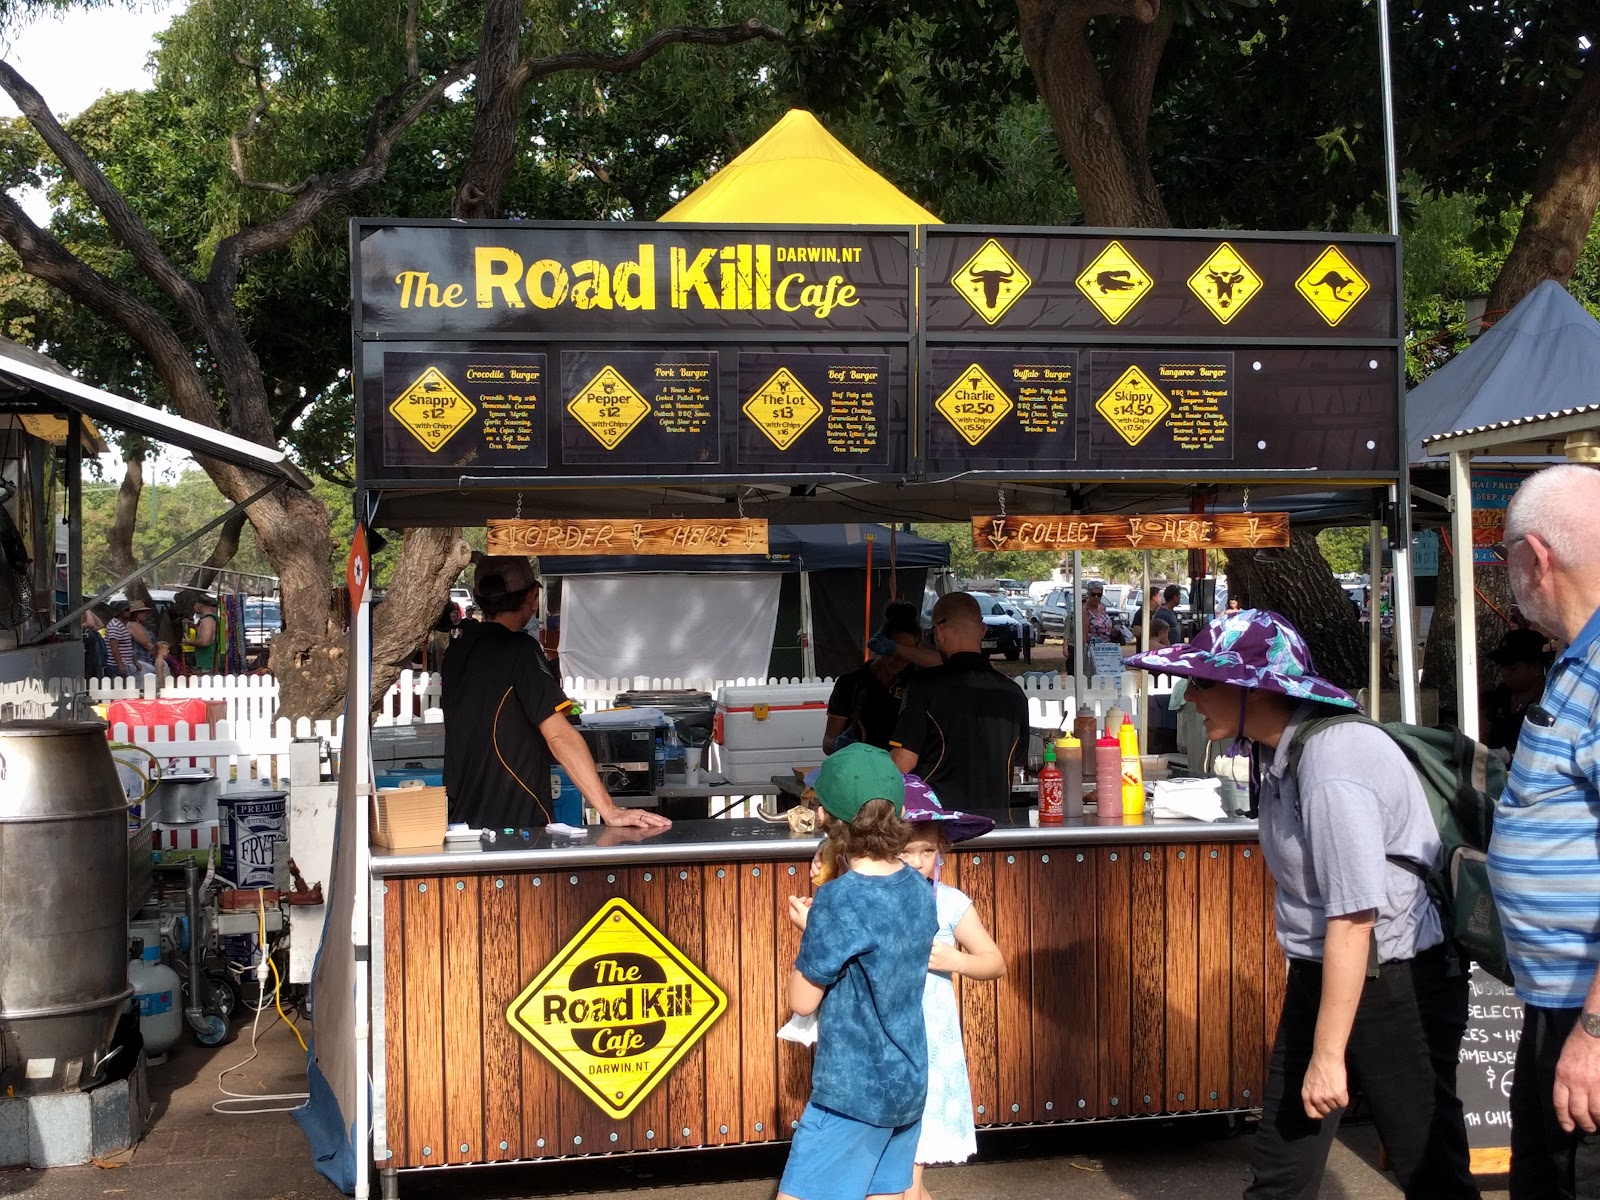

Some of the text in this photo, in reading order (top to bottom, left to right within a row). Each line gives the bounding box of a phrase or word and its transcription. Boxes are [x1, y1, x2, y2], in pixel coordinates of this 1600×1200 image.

[395, 244, 860, 319] The Road Kill Cafe
[467, 369, 540, 381] Crocodile Burger
[655, 368, 709, 379] Pork Burger
[828, 370, 878, 382] Beef Burger
[1013, 369, 1071, 380] Buffalo Burger
[1159, 367, 1226, 378] Kangaroo Burger
[409, 394, 457, 408] Snappy
[587, 393, 632, 406] Pepper
[761, 394, 806, 405] The Lot
[954, 390, 995, 400] Charlie
[1115, 391, 1153, 404] Skippy
[422, 408, 445, 419] $12
[599, 407, 620, 418] $12
[772, 406, 794, 418] $13
[954, 403, 995, 414] $12.50
[1113, 404, 1154, 416] $14.50
[432, 422, 452, 430] Chips
[524, 525, 732, 549] ORDER HERE
[1018, 521, 1213, 543] COLLECT HERE
[593, 960, 642, 983] The
[543, 984, 693, 1025] Road Kill
[1468, 1005, 1524, 1019] SELECTI
[591, 1027, 645, 1057] Cafe
